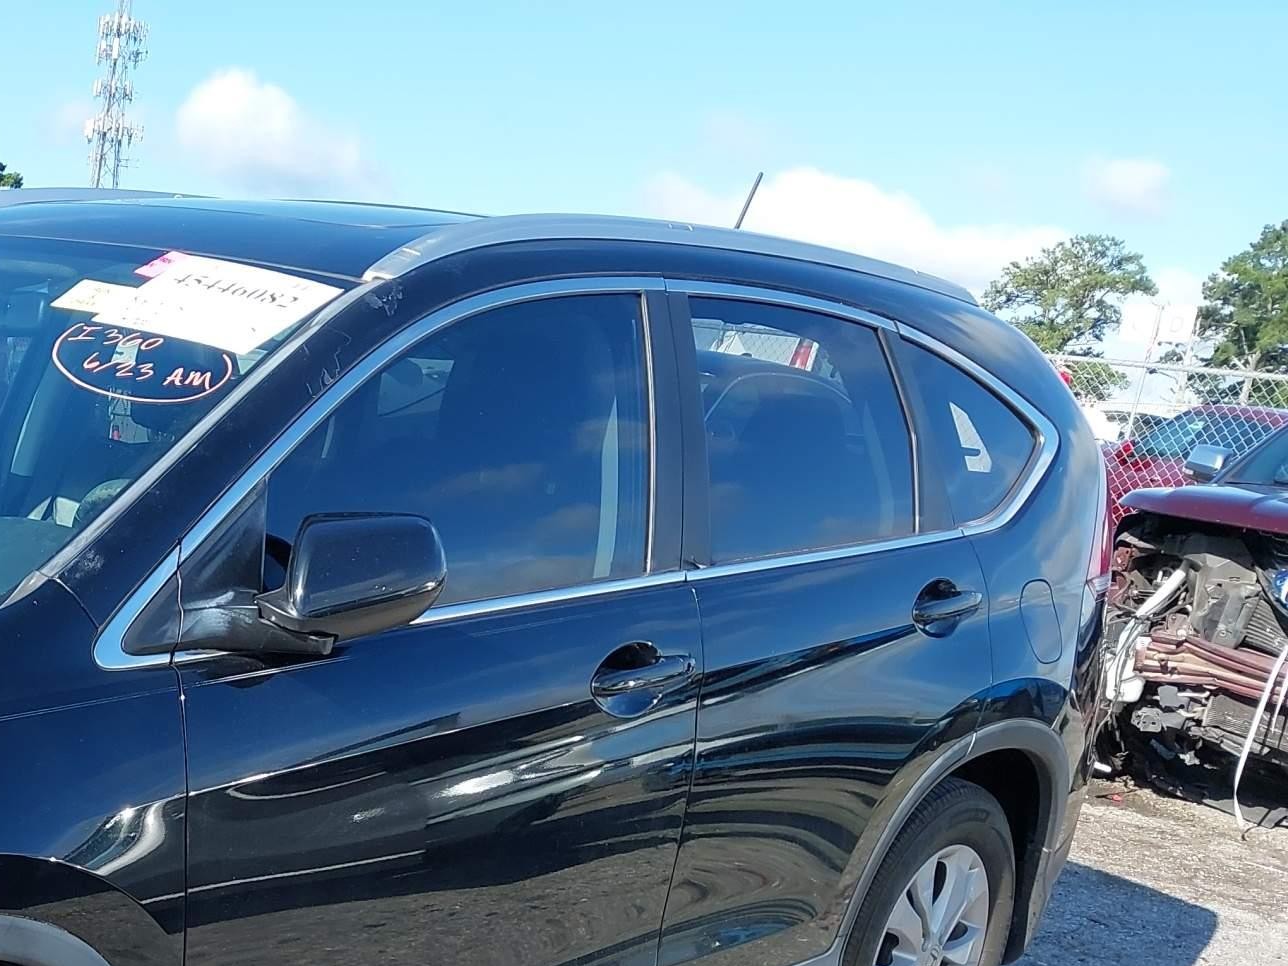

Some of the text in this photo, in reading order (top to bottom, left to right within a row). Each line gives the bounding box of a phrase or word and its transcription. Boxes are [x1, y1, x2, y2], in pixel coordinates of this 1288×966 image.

[174, 273, 300, 309] 45446082
[82, 352, 214, 390] 6/23 AM
